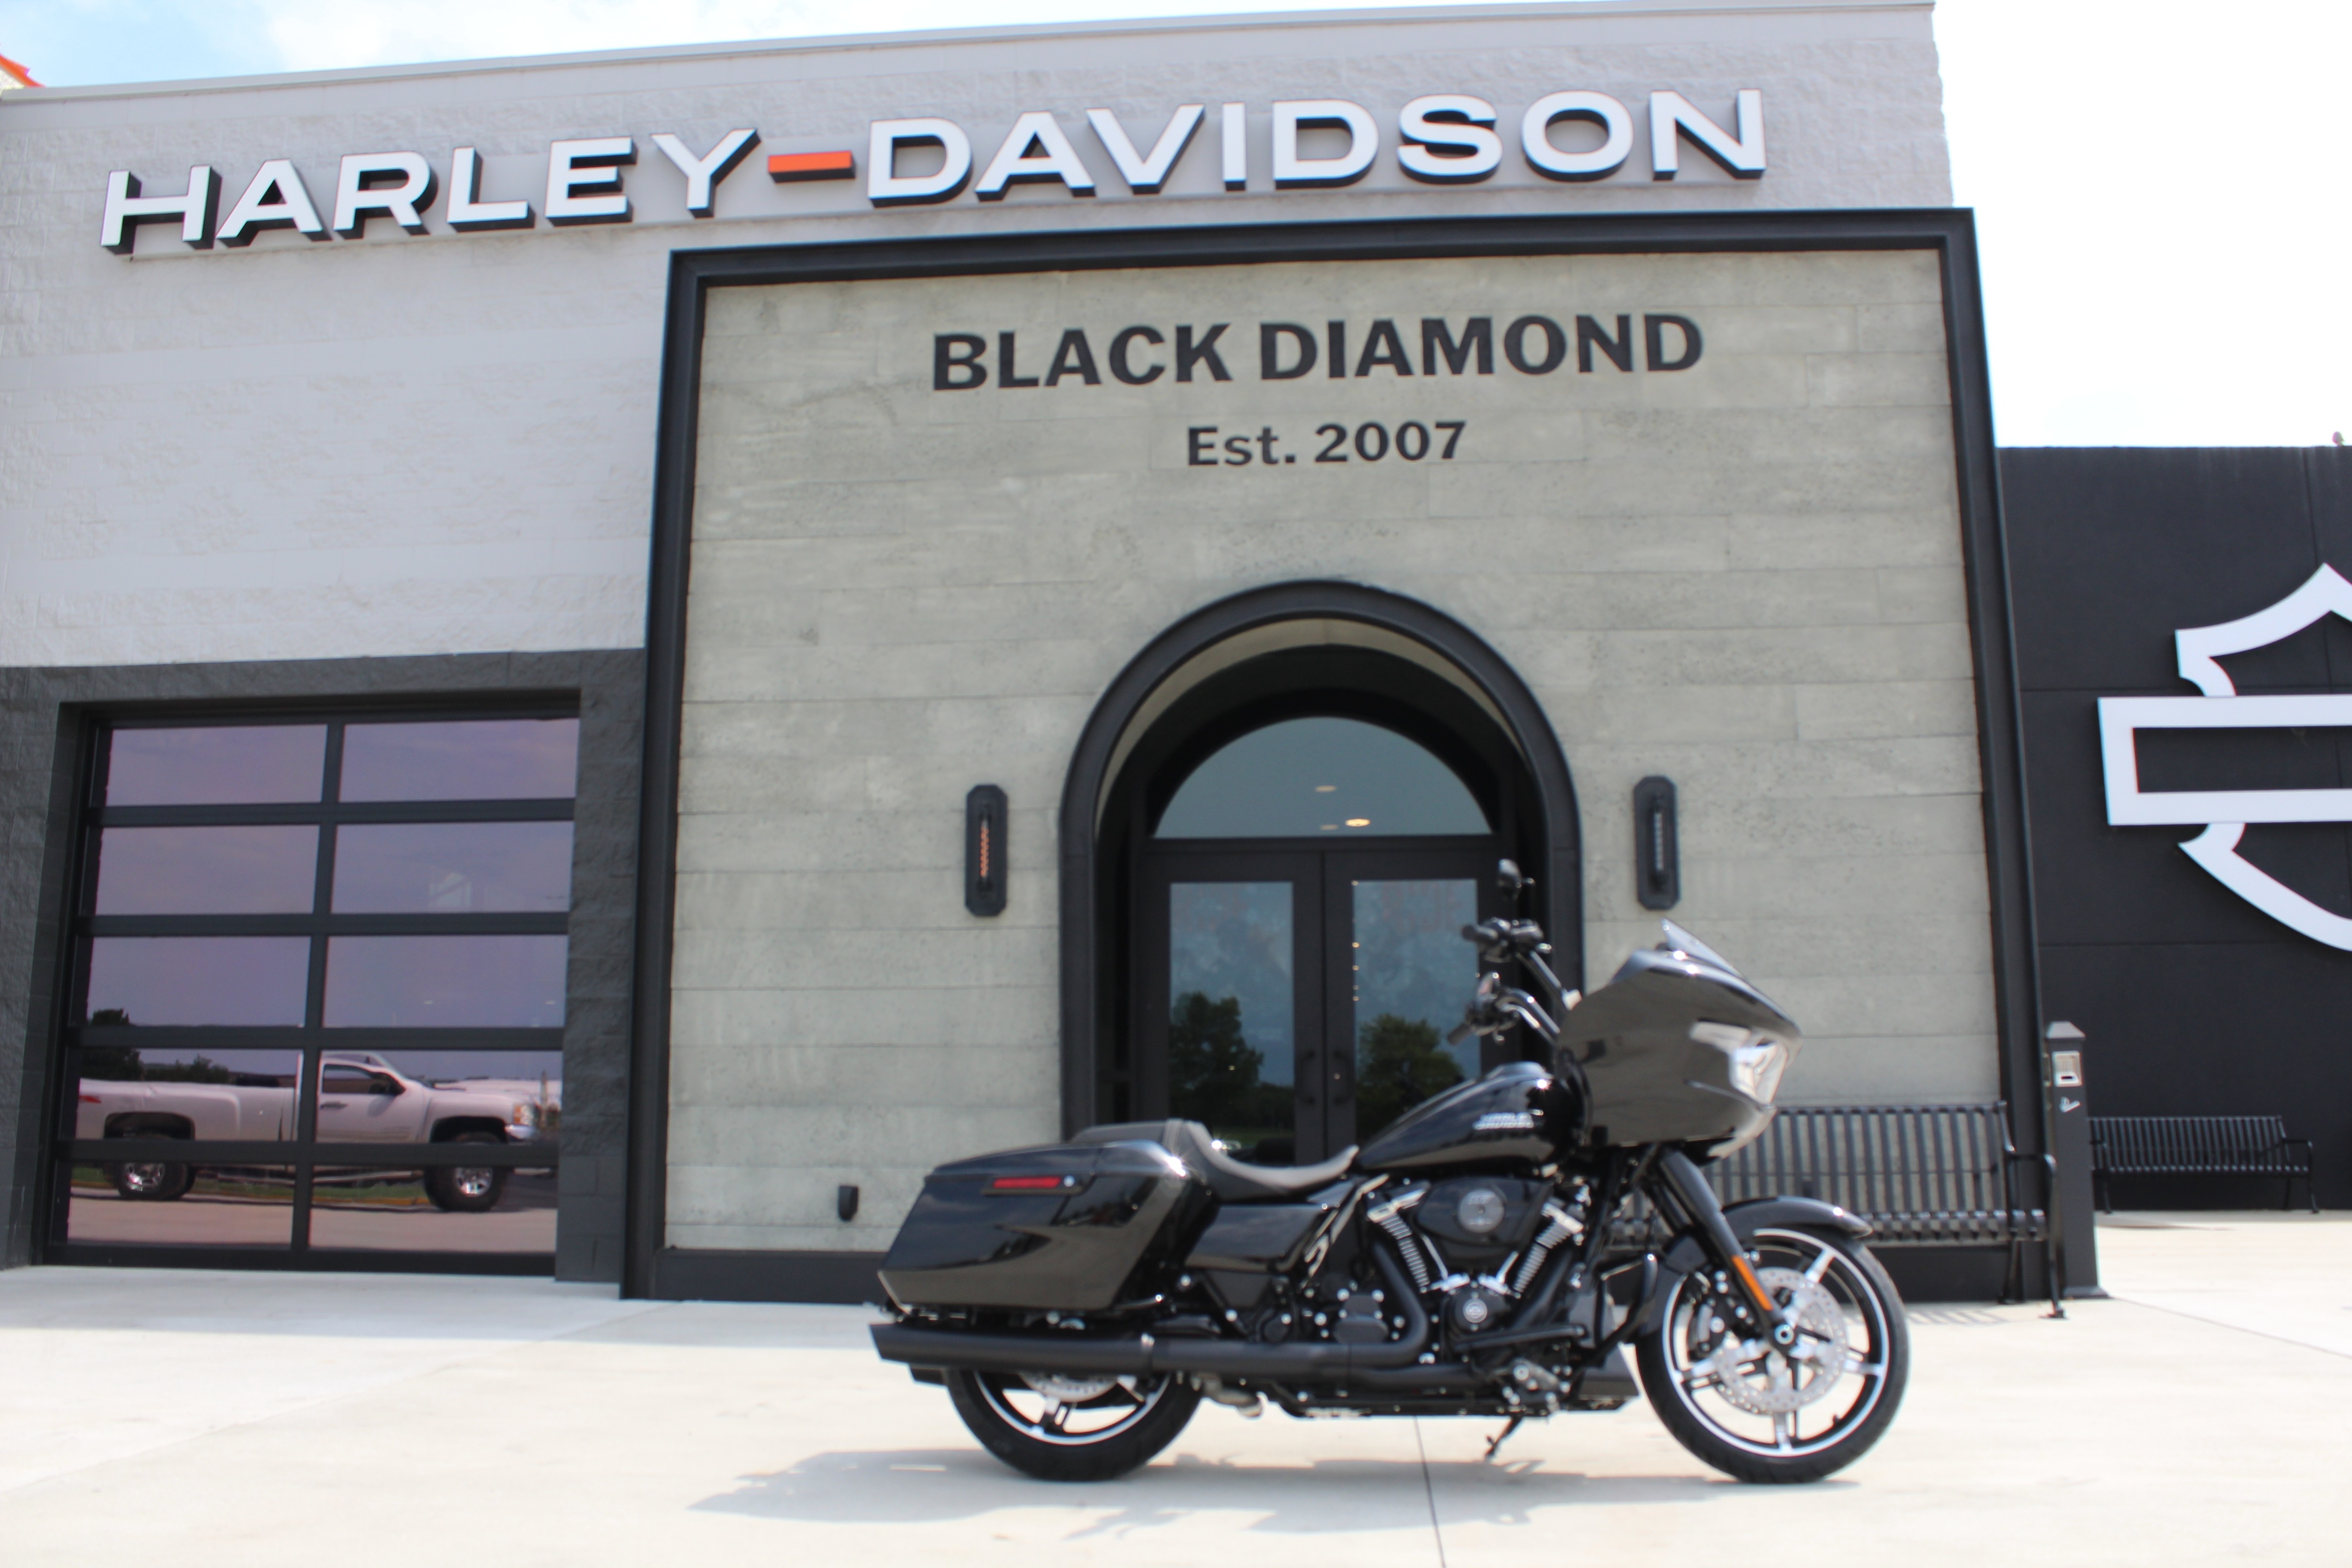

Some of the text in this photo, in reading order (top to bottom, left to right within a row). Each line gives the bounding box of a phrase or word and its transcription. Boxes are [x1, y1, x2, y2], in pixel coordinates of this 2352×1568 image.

[100, 88, 1768, 255] HARLEY-DAVIDSON
[932, 313, 1704, 392] BLACK DIAMOND
[1187, 421, 1466, 467] Est. 2007
